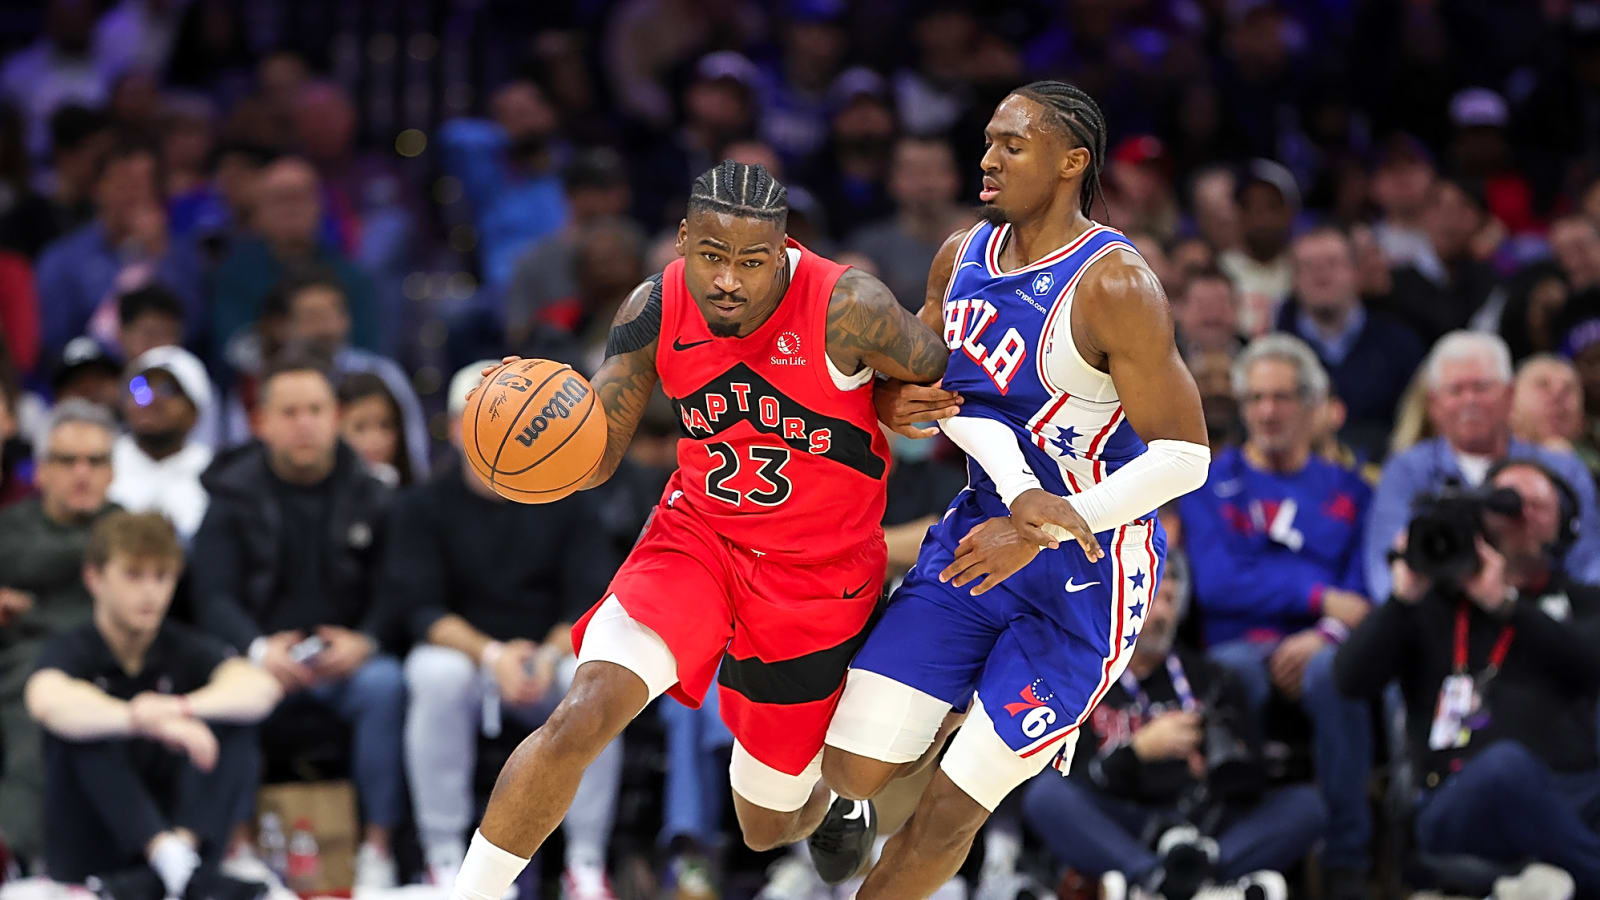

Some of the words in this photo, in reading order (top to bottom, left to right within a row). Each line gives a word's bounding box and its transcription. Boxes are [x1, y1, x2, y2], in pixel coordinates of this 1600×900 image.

[1015, 288, 1048, 315] crypto.com
[770, 356, 788, 366] Sun
[789, 356, 807, 366] Life
[943, 299, 1027, 396] HILA
[515, 376, 589, 447] Wilson
[680, 382, 832, 455] RAPTORS
[704, 441, 793, 507] 23
